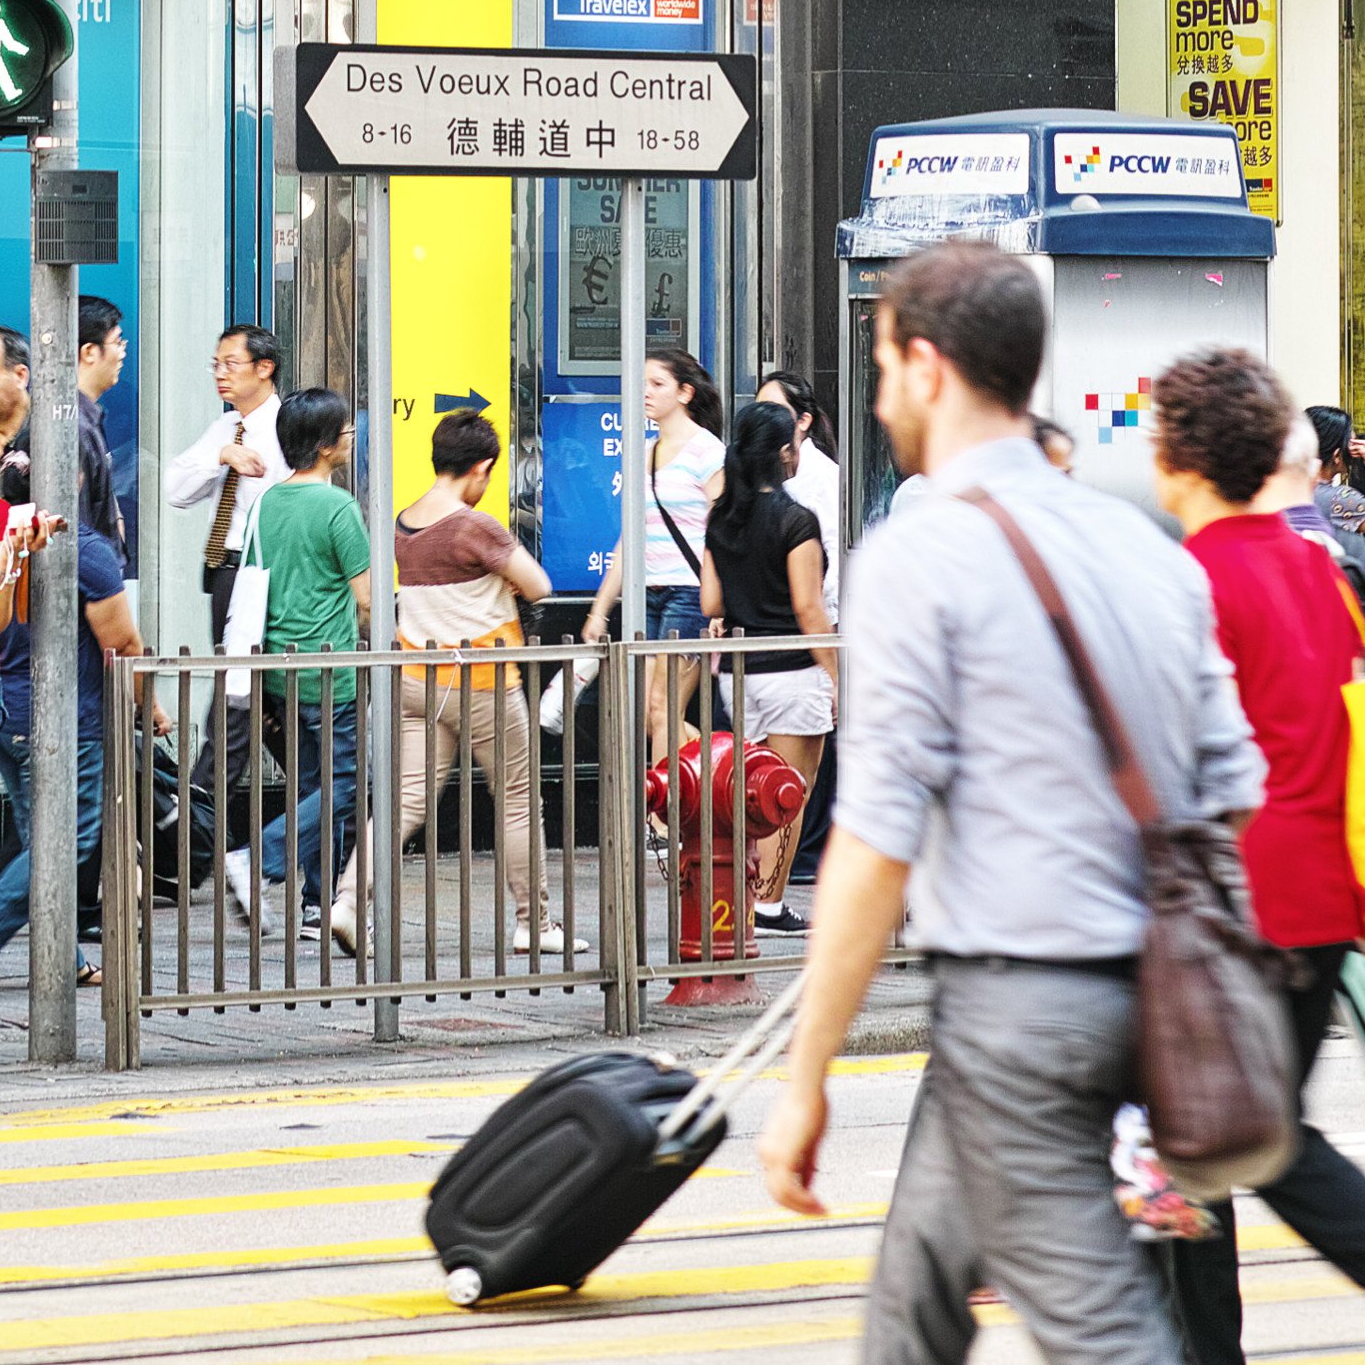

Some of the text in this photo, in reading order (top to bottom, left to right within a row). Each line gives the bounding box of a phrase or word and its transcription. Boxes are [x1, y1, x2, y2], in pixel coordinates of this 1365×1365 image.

[656, 0, 696, 9] worldwide
[656, 7, 683, 19] money
[1176, 28, 1234, 52] more
[346, 63, 712, 102] Des Voeux Road Central
[1188, 78, 1274, 118] SAVE
[362, 116, 700, 159] 8-16 德輔道中 18-58
[1219, 120, 1272, 141] ore
[906, 156, 958, 175] PCCW
[1109, 155, 1171, 174] PCCW
